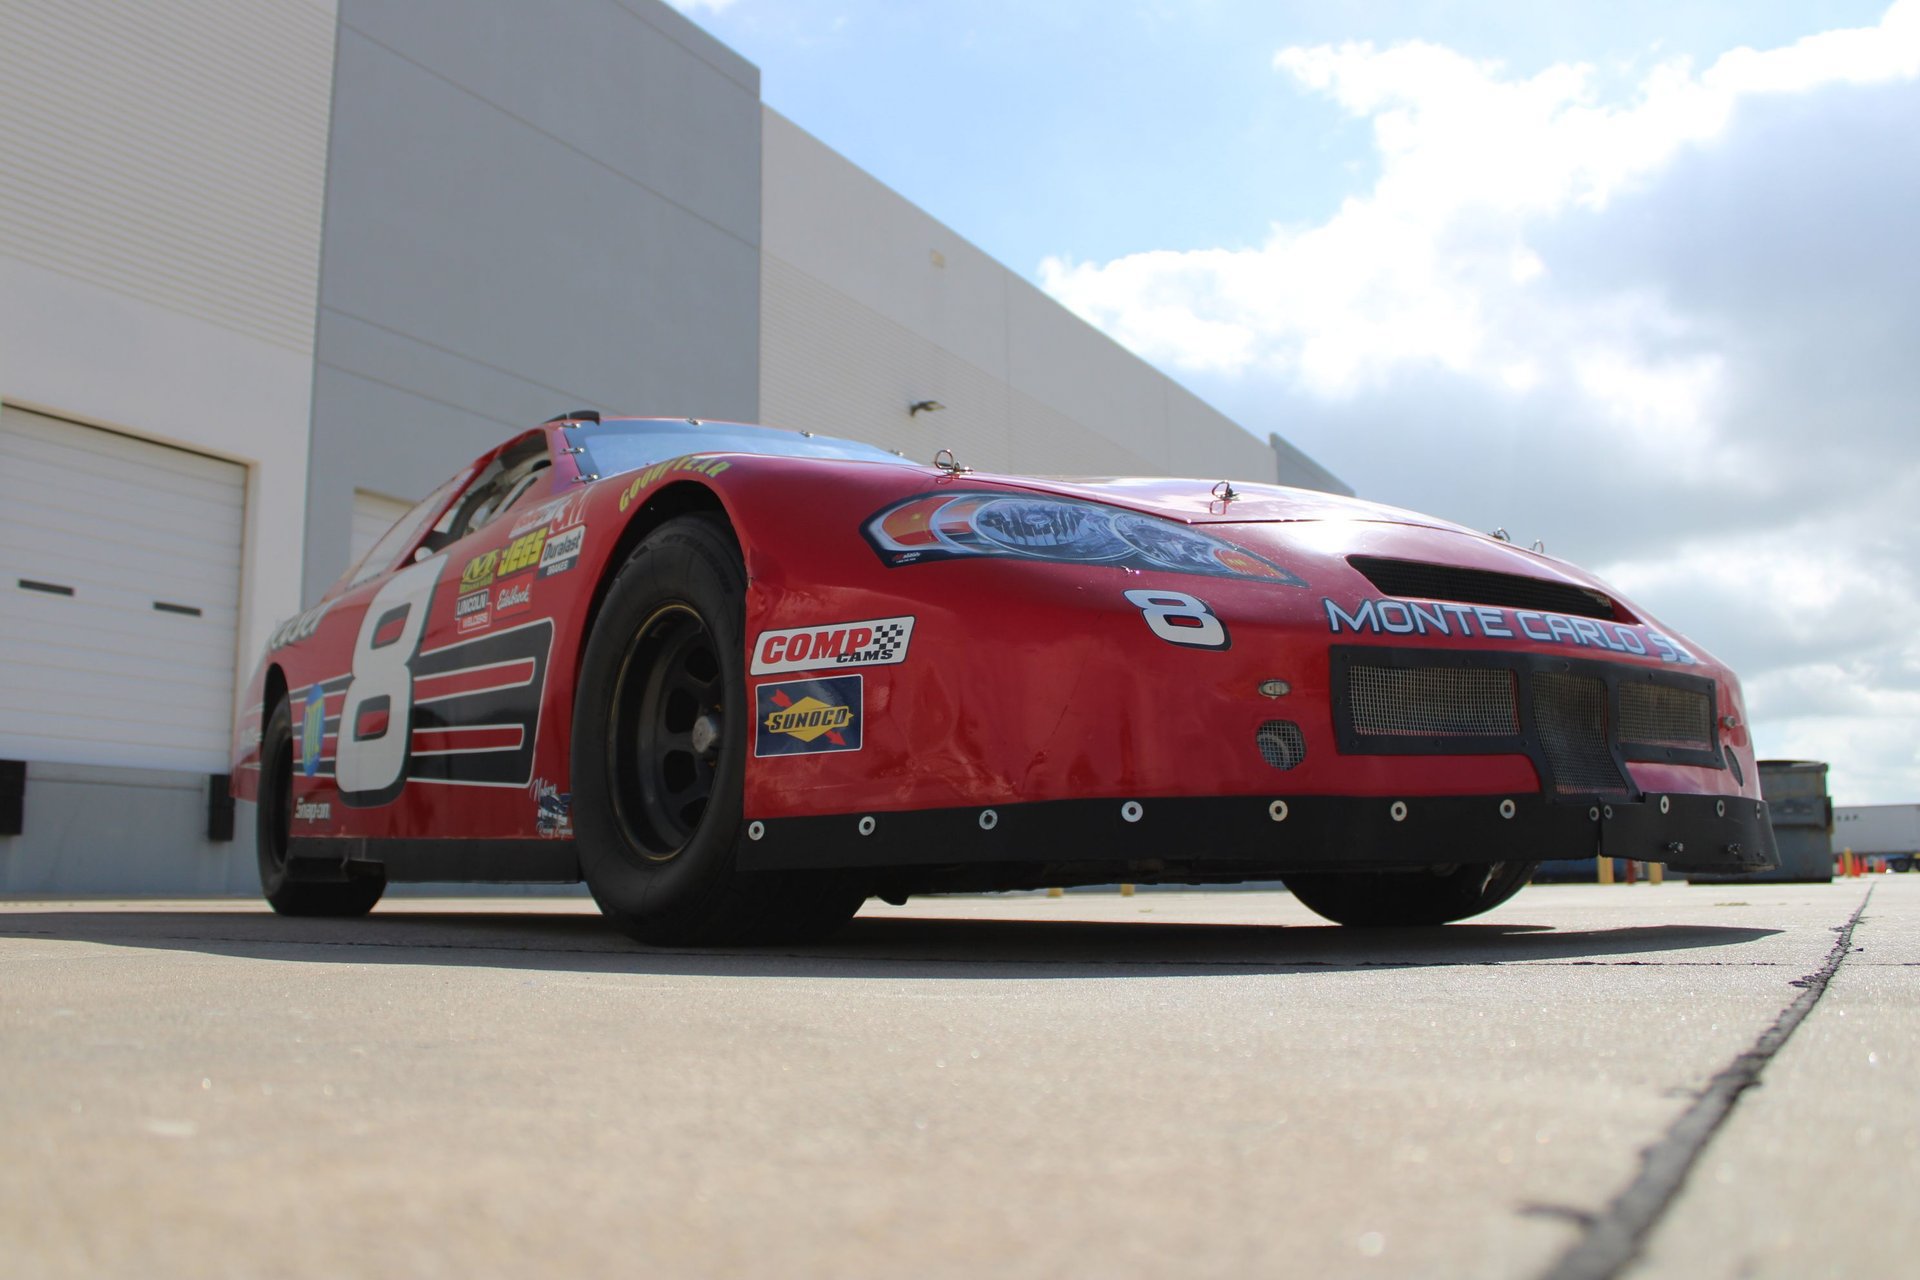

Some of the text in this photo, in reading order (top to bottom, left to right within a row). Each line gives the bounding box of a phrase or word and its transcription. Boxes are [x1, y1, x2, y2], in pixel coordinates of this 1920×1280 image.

[619, 456, 731, 512] GOODYEAR
[497, 527, 549, 577] JEGS
[543, 531, 582, 562] Duralast
[456, 592, 488, 617] LINCOLN
[1122, 589, 1230, 650] 8
[1324, 597, 1515, 638] MONTE
[1516, 611, 1646, 655] CARLO
[760, 627, 874, 665] COMP
[836, 648, 894, 664] CAMS
[335, 554, 450, 795] 8
[769, 707, 849, 731] SUNOCO
